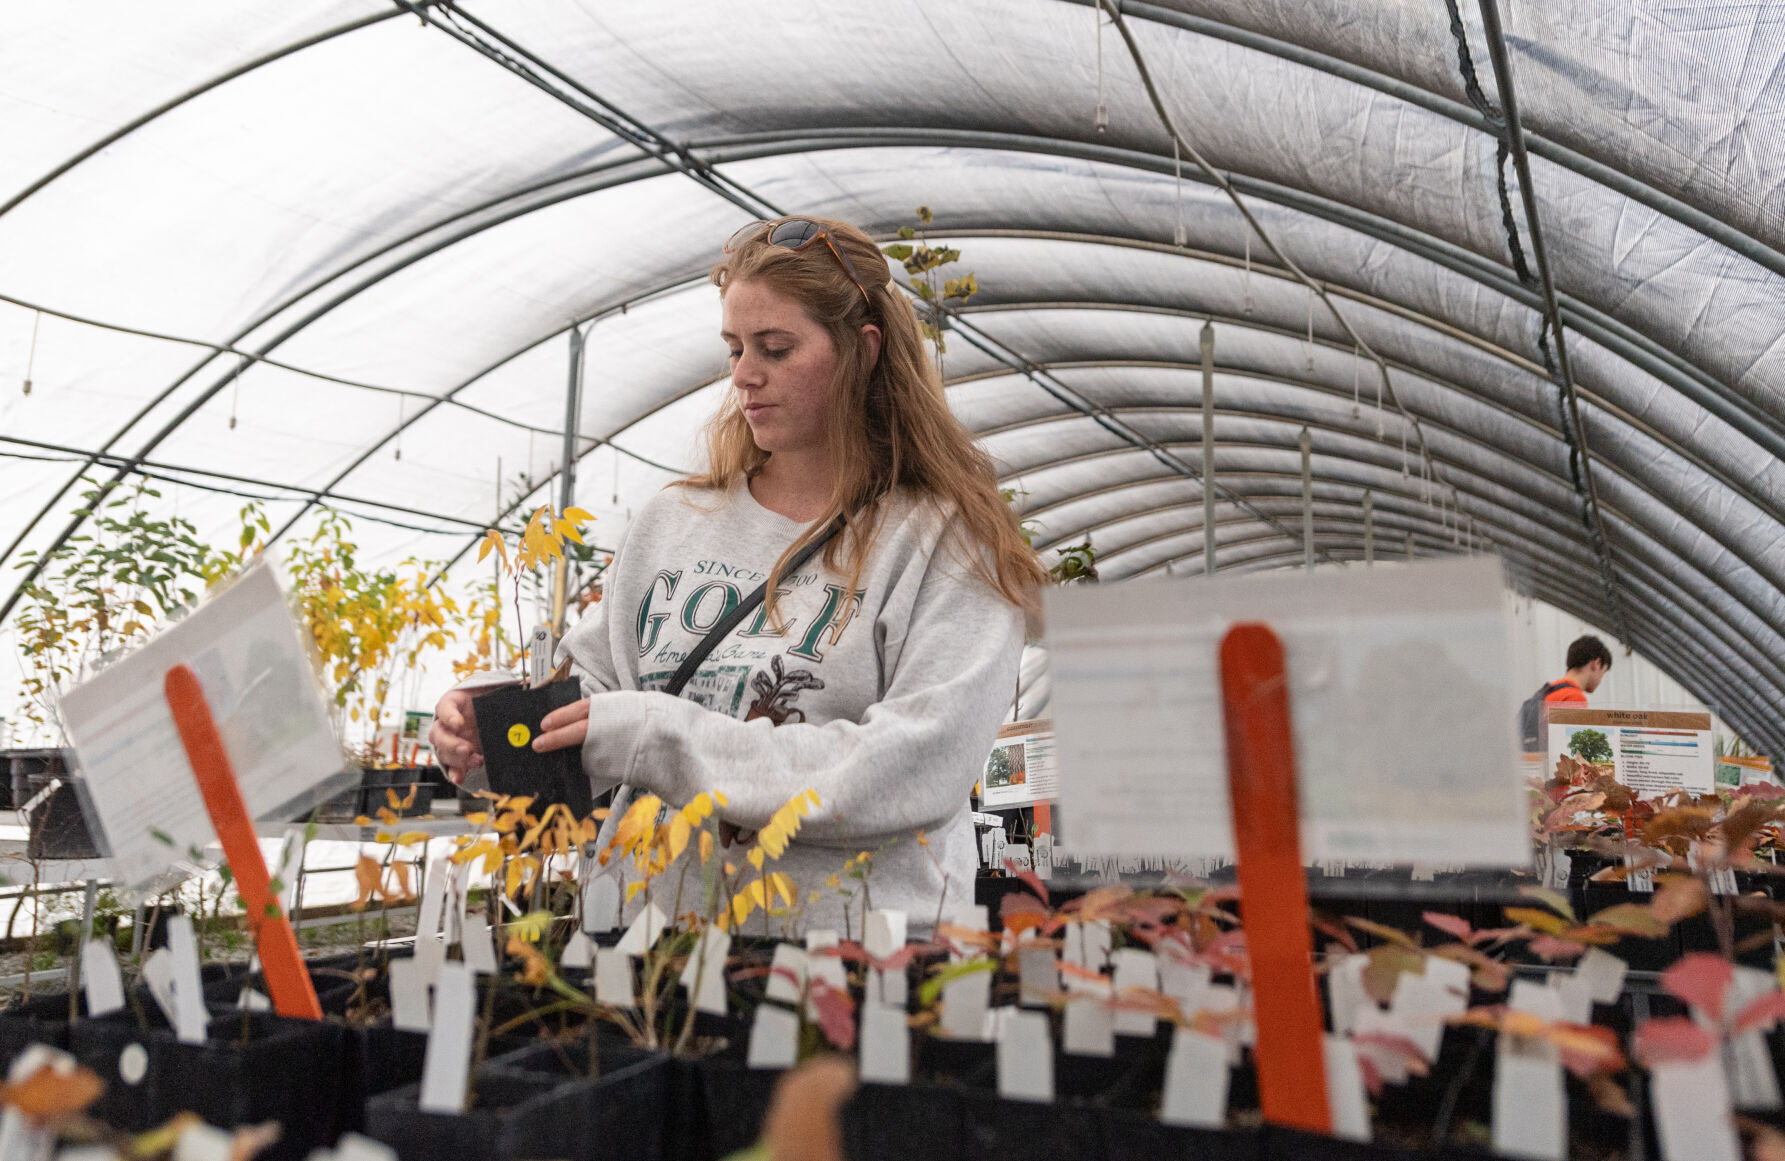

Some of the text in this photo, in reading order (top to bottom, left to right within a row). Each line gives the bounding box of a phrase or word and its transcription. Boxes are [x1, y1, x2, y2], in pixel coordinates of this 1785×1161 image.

[693, 559, 766, 582] SINCE
[636, 569, 868, 664] GOLF
[1606, 711, 1631, 720] white
